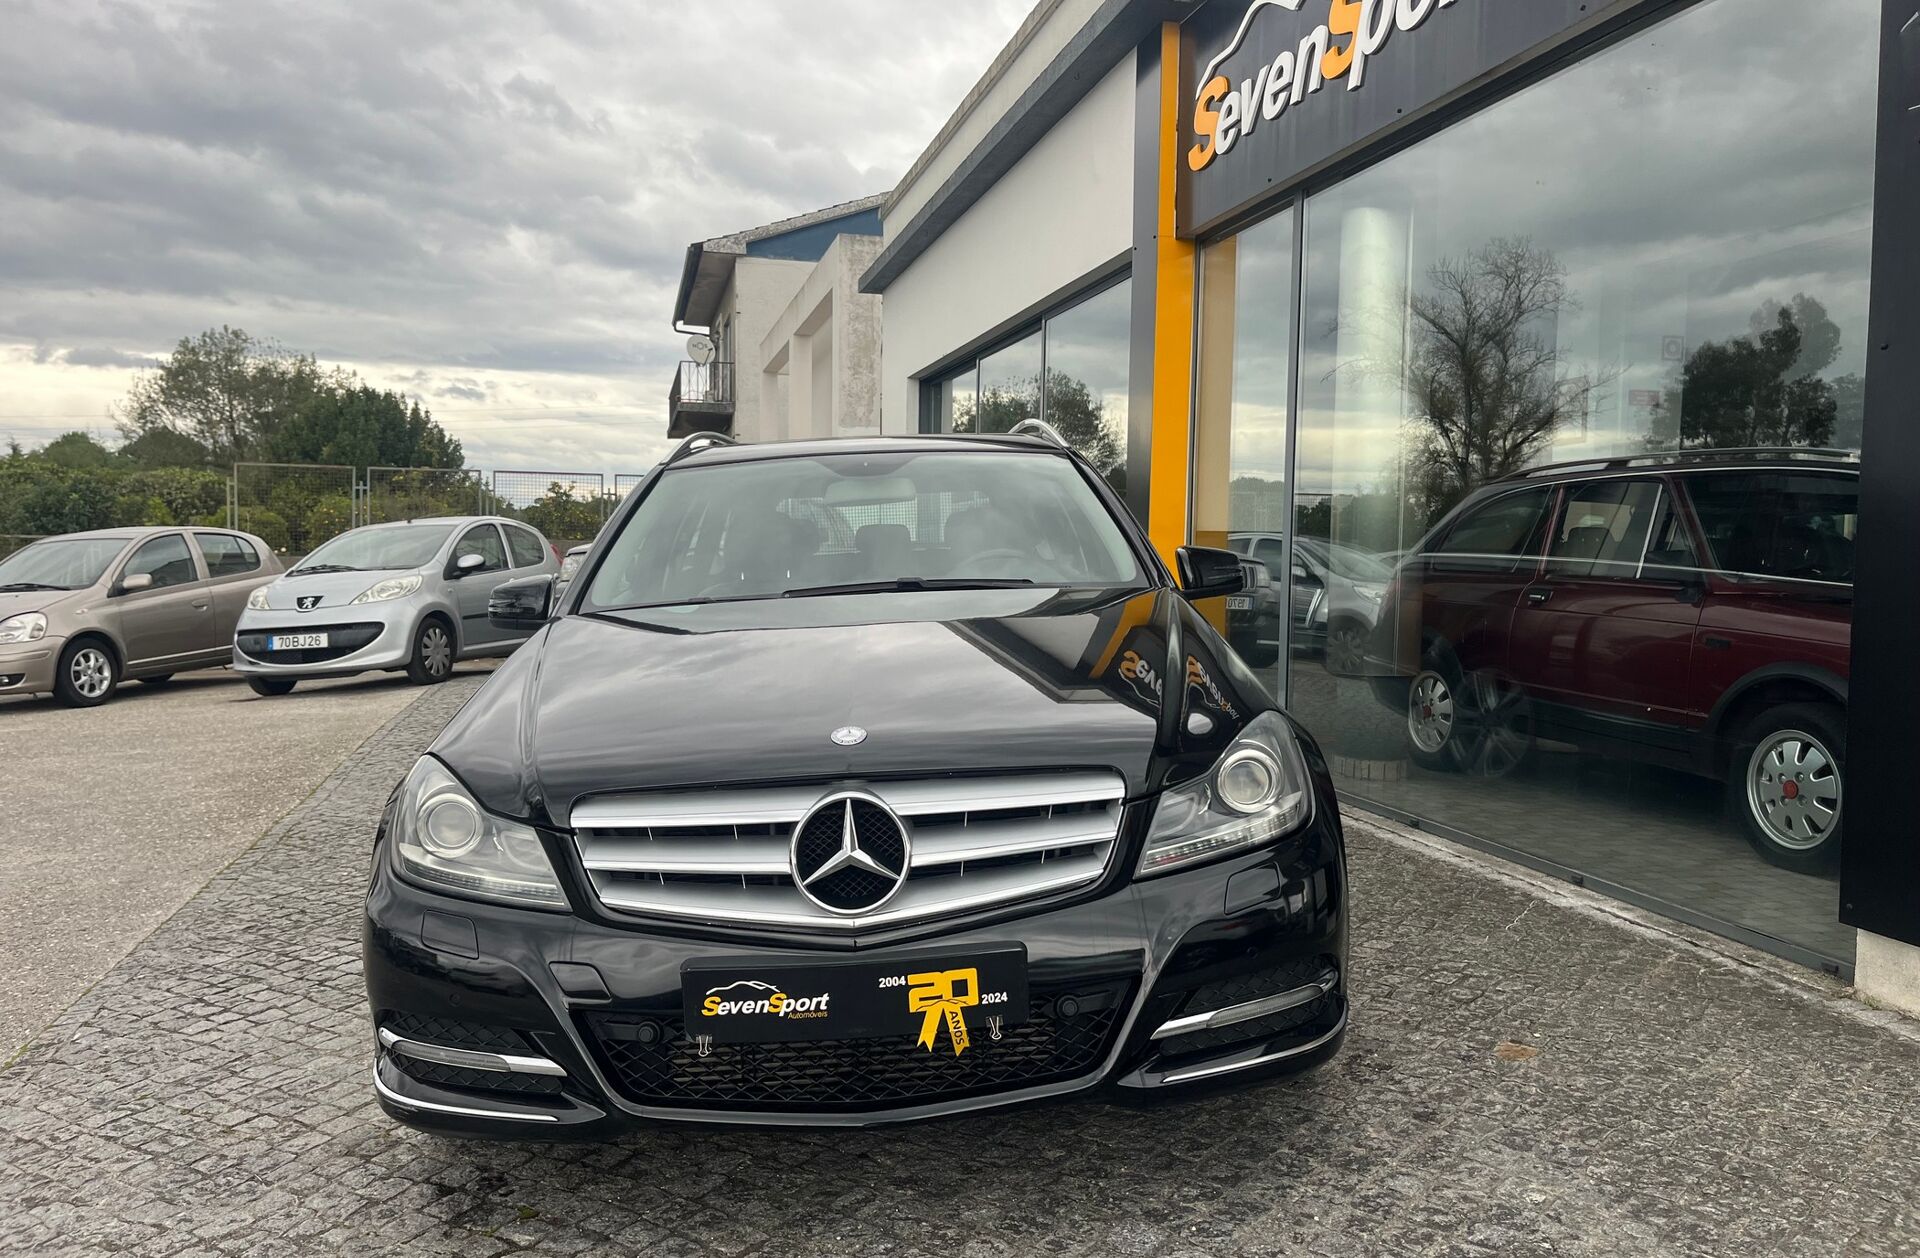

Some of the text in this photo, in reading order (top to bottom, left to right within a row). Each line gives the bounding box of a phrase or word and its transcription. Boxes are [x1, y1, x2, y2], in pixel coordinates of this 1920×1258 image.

[1188, 0, 1452, 171] SevenSp
[278, 635, 321, 648] 70BJ26
[878, 976, 906, 988] 2004
[908, 967, 979, 1012] 20
[701, 992, 829, 1016] SevenSport
[981, 991, 1008, 1004] 2024
[948, 1010, 966, 1046] ANOS
